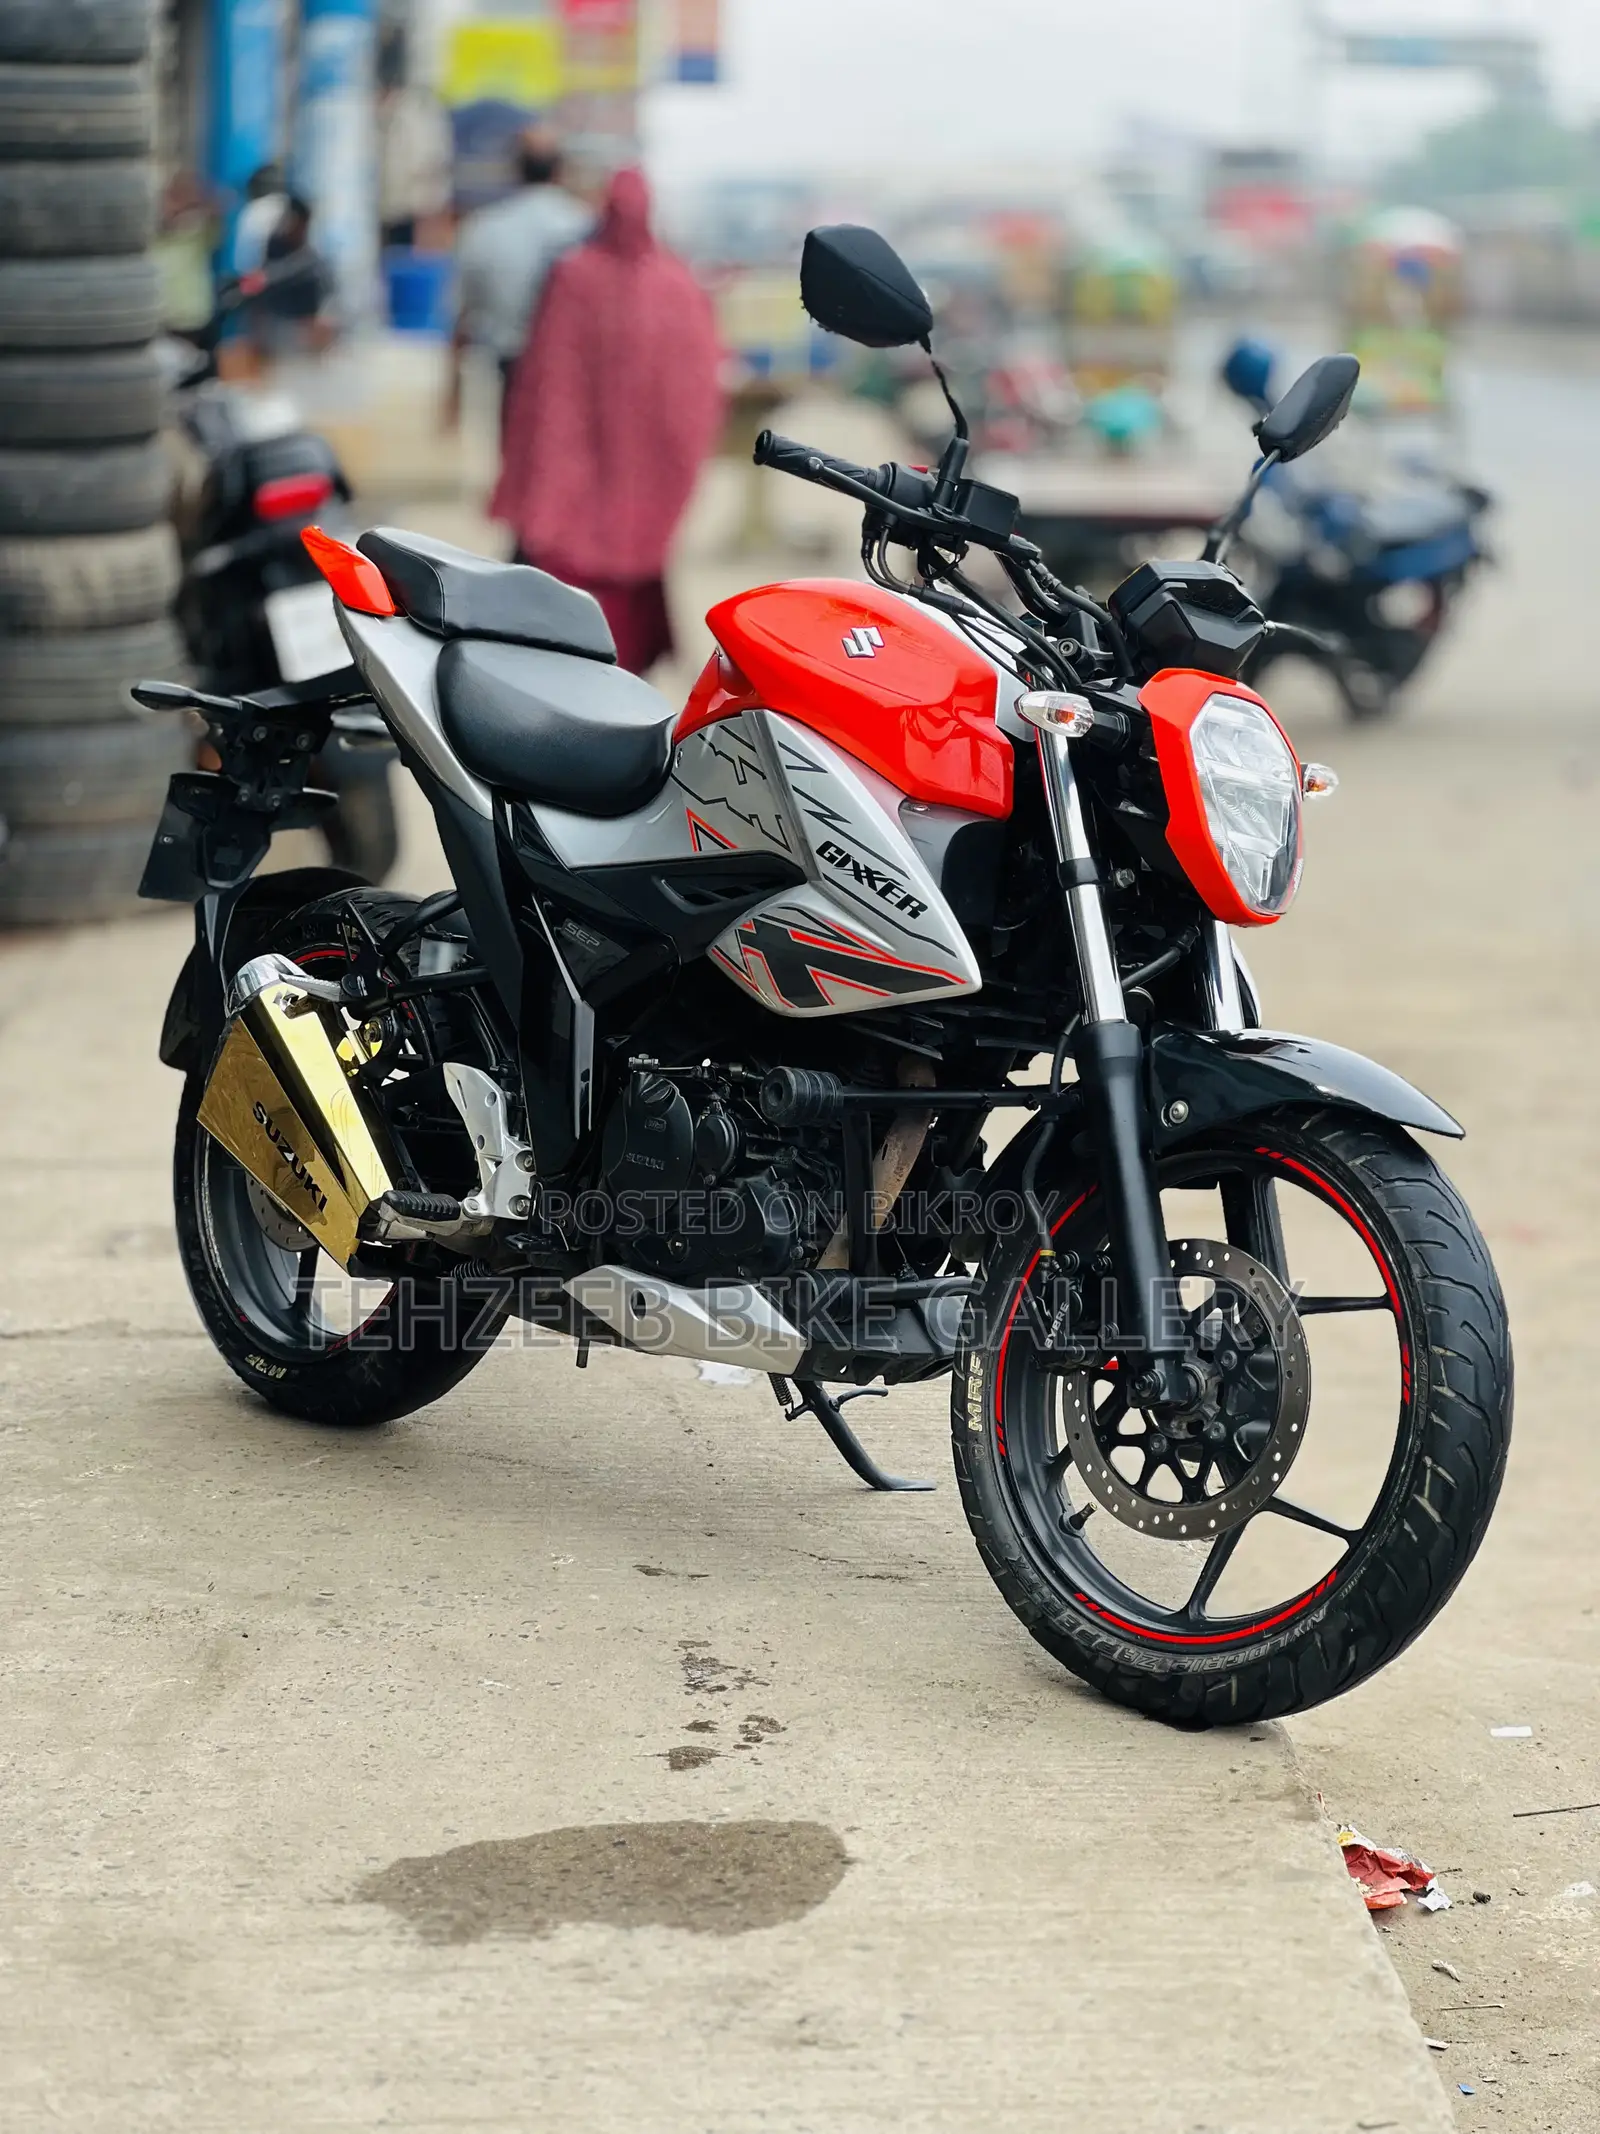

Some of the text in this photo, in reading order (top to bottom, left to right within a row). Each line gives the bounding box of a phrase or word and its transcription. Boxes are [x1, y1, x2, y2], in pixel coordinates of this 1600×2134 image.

[815, 840, 929, 920] GIXXER
[564, 922, 601, 948] SEP
[252, 1100, 328, 1213] SUZUKI
[1043, 1301, 1070, 1349] BYBRE
[967, 1350, 984, 1433] MRF
